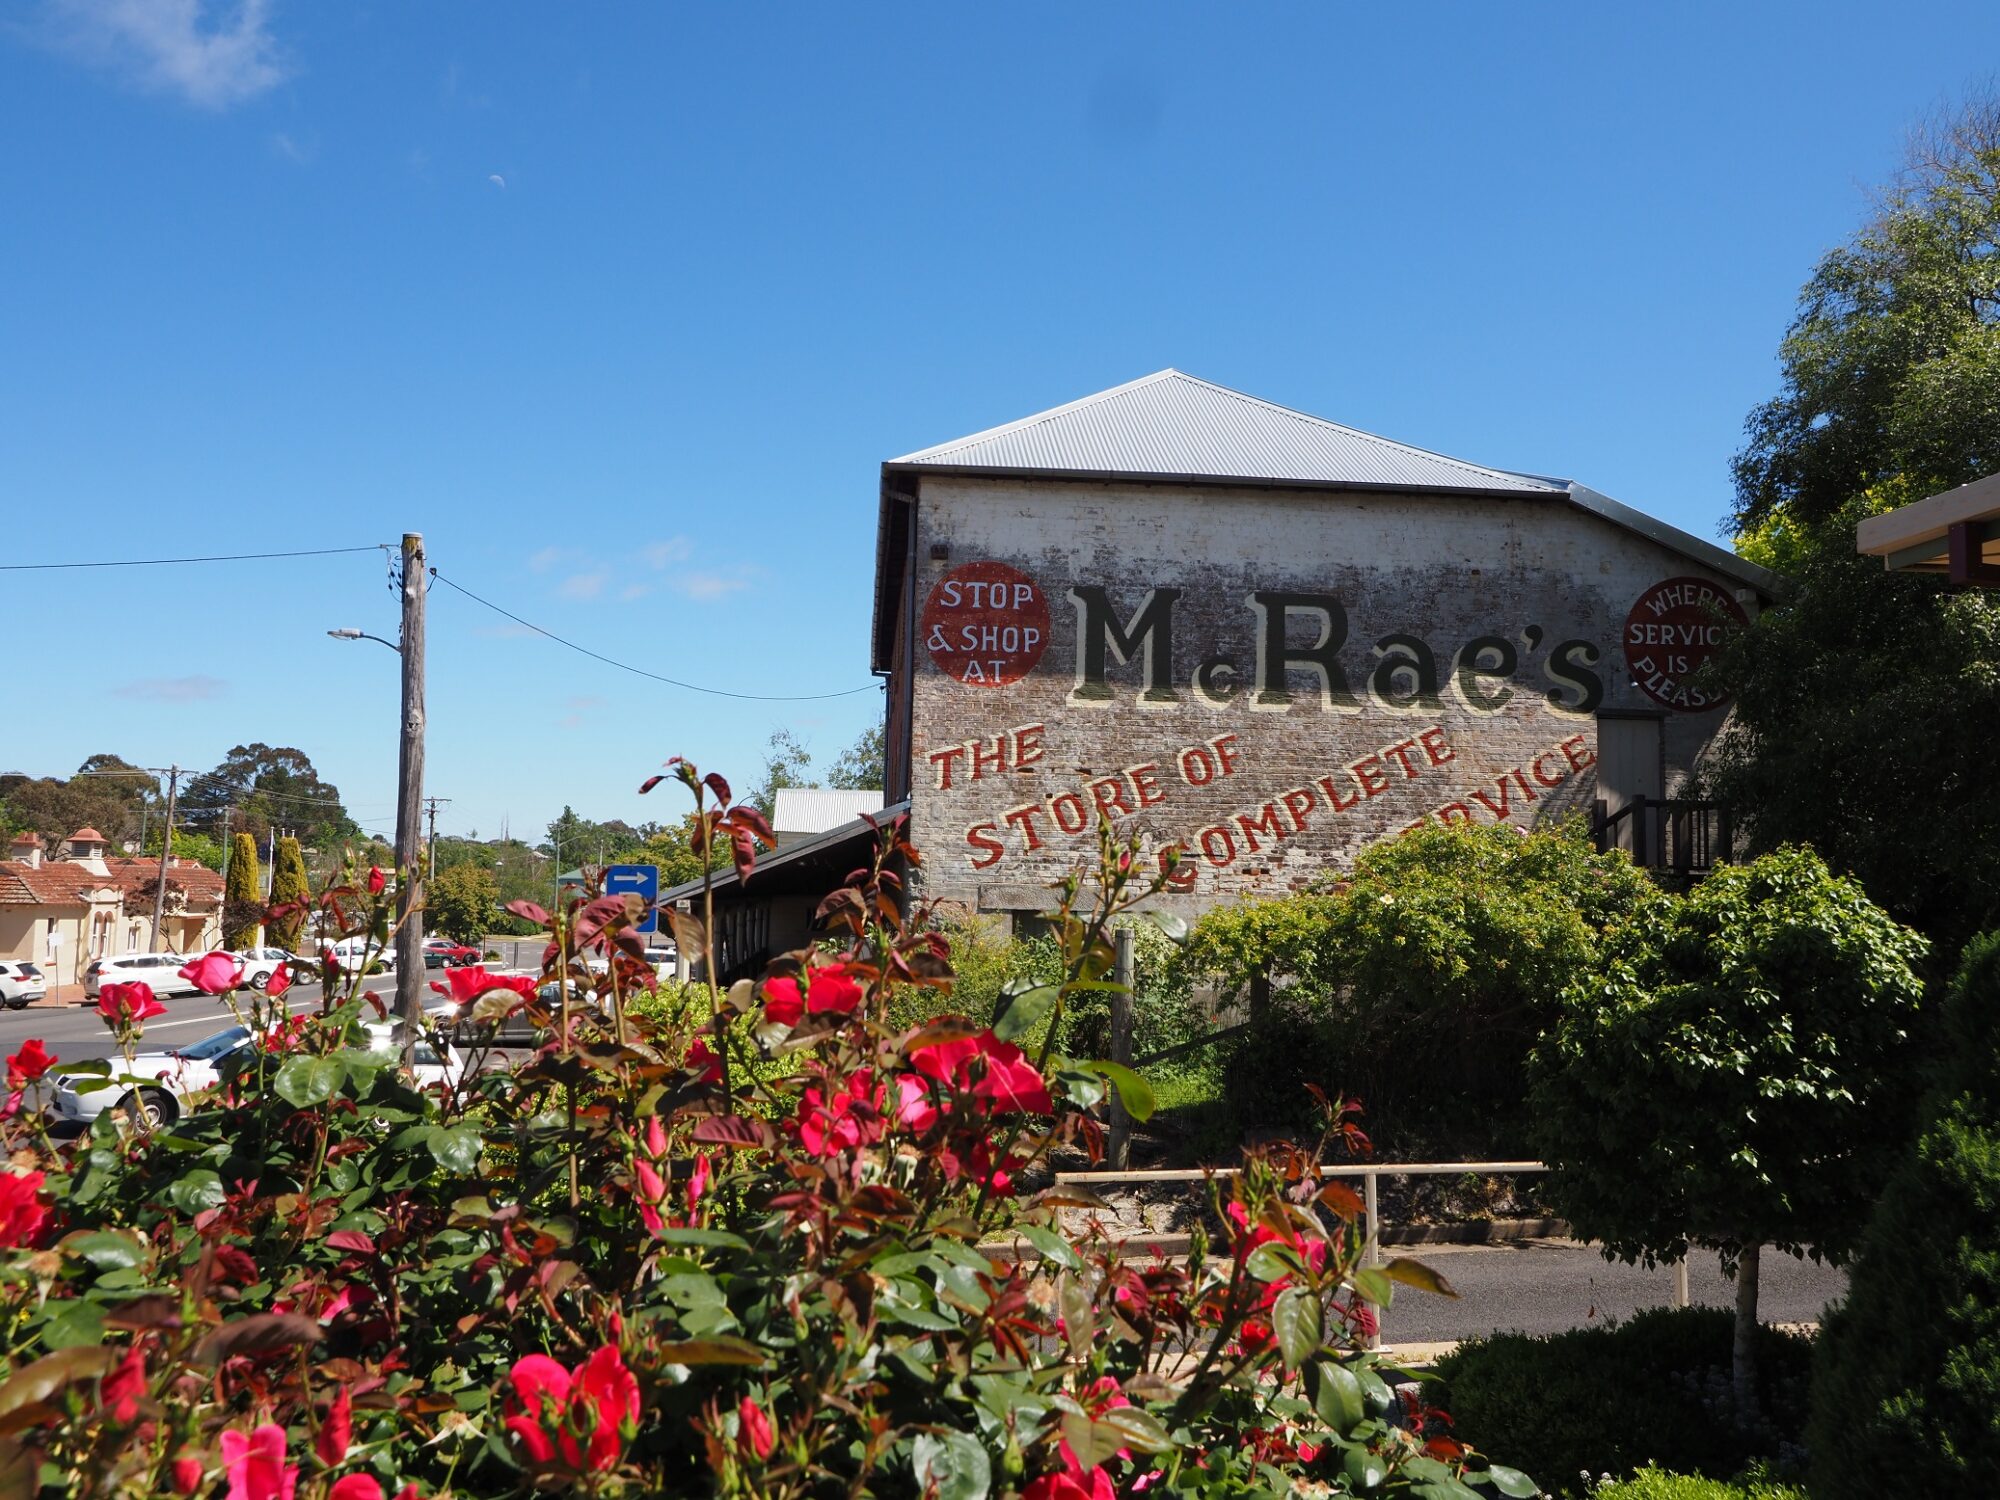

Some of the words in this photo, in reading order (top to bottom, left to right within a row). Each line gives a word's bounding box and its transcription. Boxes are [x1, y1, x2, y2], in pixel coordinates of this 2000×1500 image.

[938, 580, 1034, 610] STOP
[926, 624, 955, 653] &
[960, 625, 1041, 653] SHOP
[1066, 586, 1604, 721] McRae's
[962, 660, 1006, 684] AT
[1668, 655, 1689, 674] IS
[926, 722, 1045, 790] THE
[964, 763, 1167, 870] STORE
[1177, 733, 1240, 787] OF
[1155, 725, 1456, 887] COMPLETE
